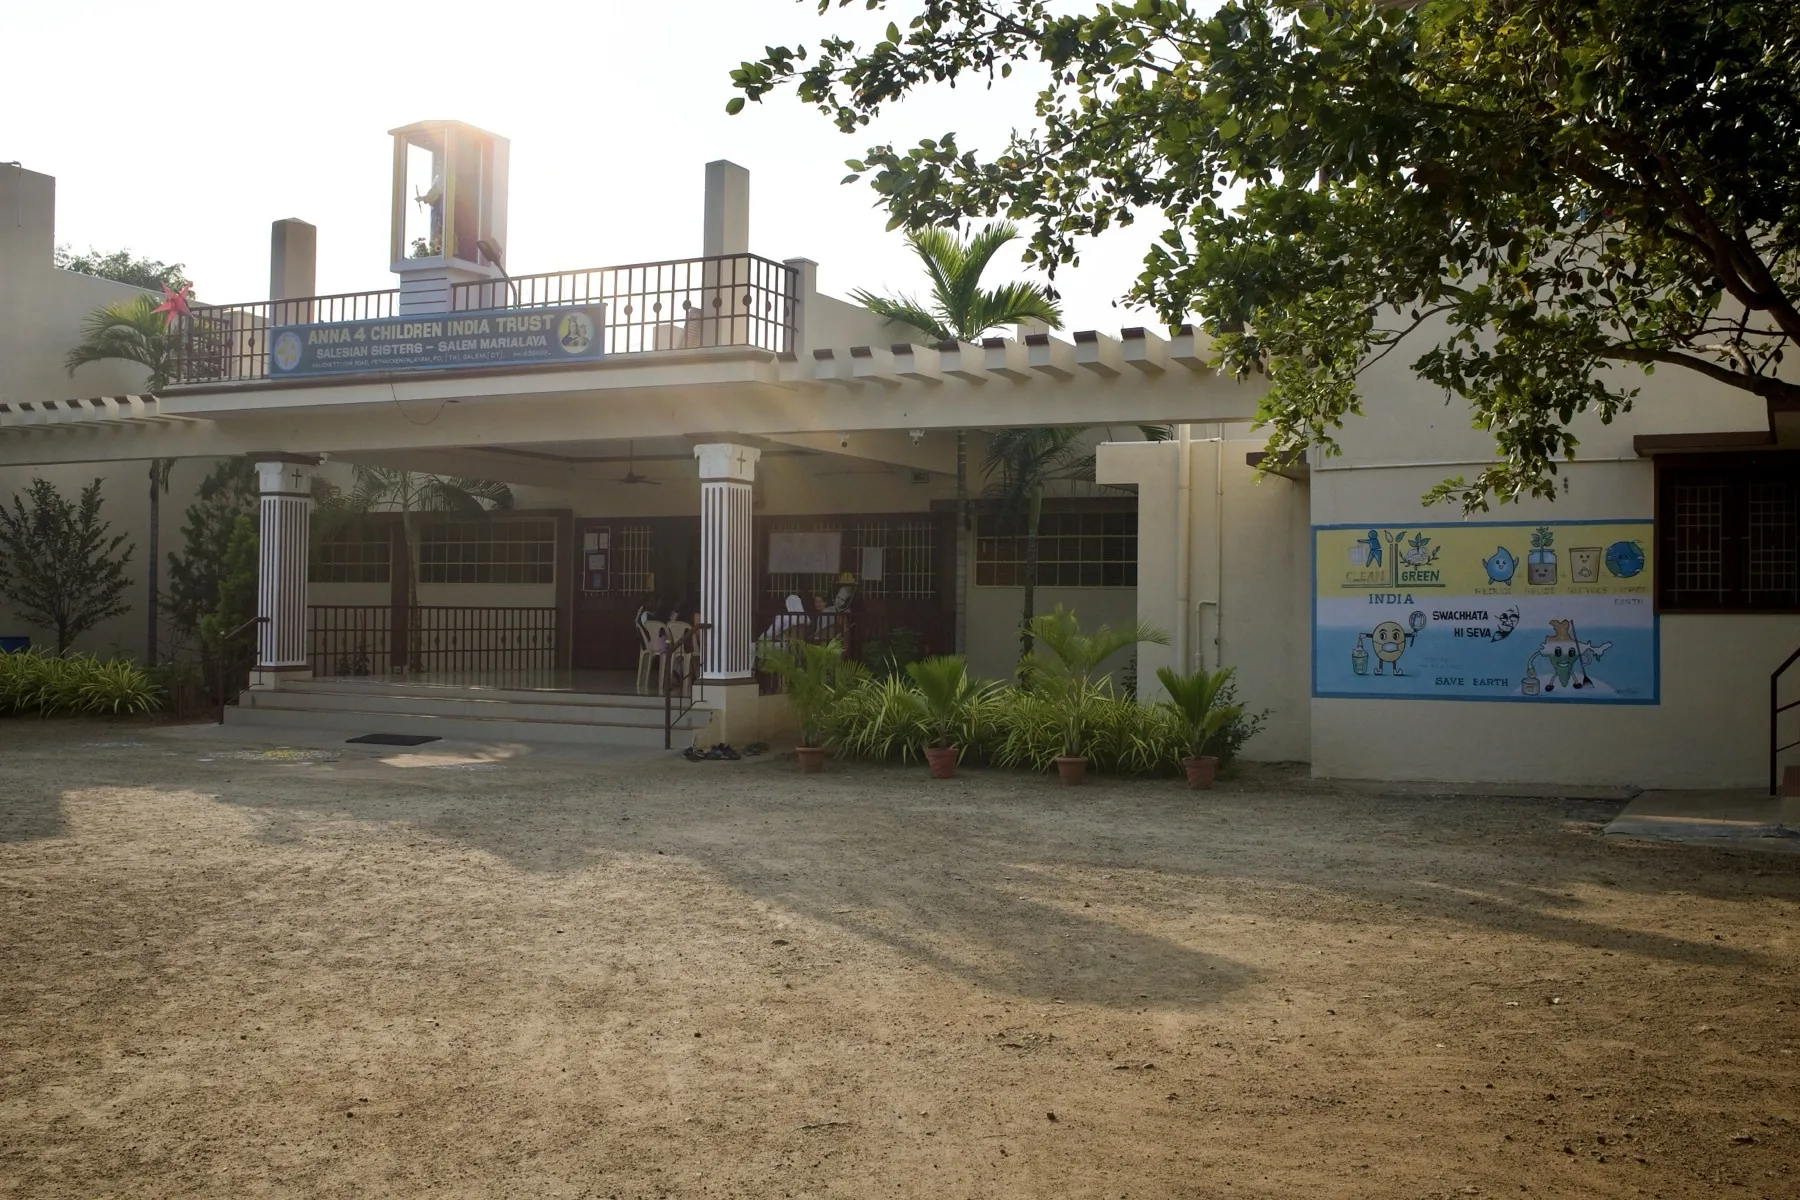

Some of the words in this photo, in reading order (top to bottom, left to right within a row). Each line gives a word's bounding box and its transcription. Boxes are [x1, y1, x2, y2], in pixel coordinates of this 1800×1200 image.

[308, 328, 351, 345] ANNA
[354, 327, 365, 342] 4
[371, 322, 441, 341] CHILDREN
[447, 319, 489, 336] INDIA
[496, 314, 554, 332] TRUST
[316, 346, 368, 359] SALESIAN
[371, 343, 423, 356] SISTERS
[438, 339, 477, 352] SALEM
[479, 335, 547, 350] MARIALAYA
[1345, 570, 1385, 582] CLEAN
[1401, 569, 1440, 582] GREEN
[1368, 593, 1415, 604] INDIA
[1432, 610, 1488, 620] SWACHHATA
[1466, 627, 1492, 638] SEVA
[1435, 677, 1465, 686] SAVE
[1472, 677, 1508, 687] EARTH
